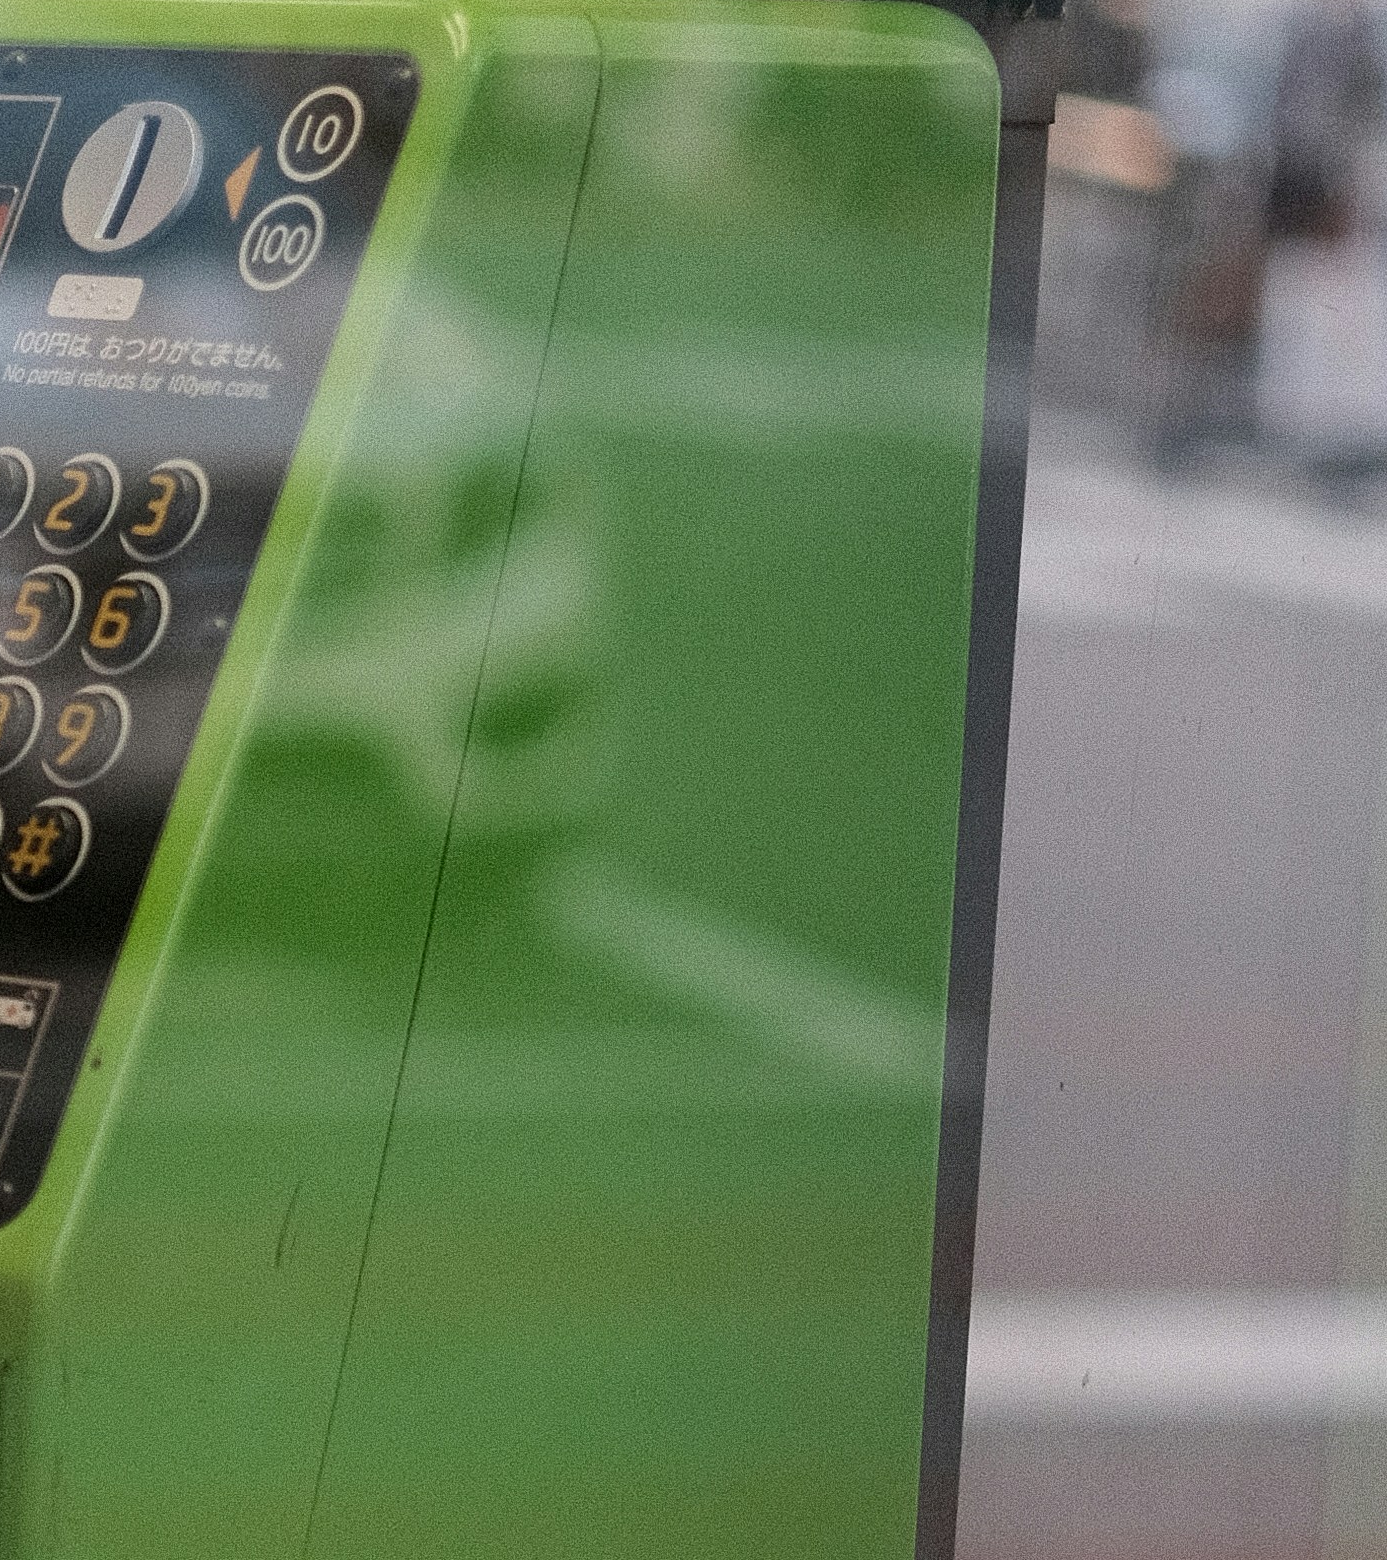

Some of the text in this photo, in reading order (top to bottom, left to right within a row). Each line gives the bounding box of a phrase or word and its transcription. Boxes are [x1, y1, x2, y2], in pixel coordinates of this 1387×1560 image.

[294, 113, 342, 156] 10
[250, 224, 311, 265] 100
[3, 363, 26, 384] No
[26, 367, 75, 388] partial
[77, 368, 136, 391] refunds
[139, 371, 163, 393] for
[43, 469, 90, 533] 2
[131, 473, 178, 538] 3
[4, 580, 52, 641] 5
[89, 585, 140, 649] 6
[55, 702, 97, 766] 9
